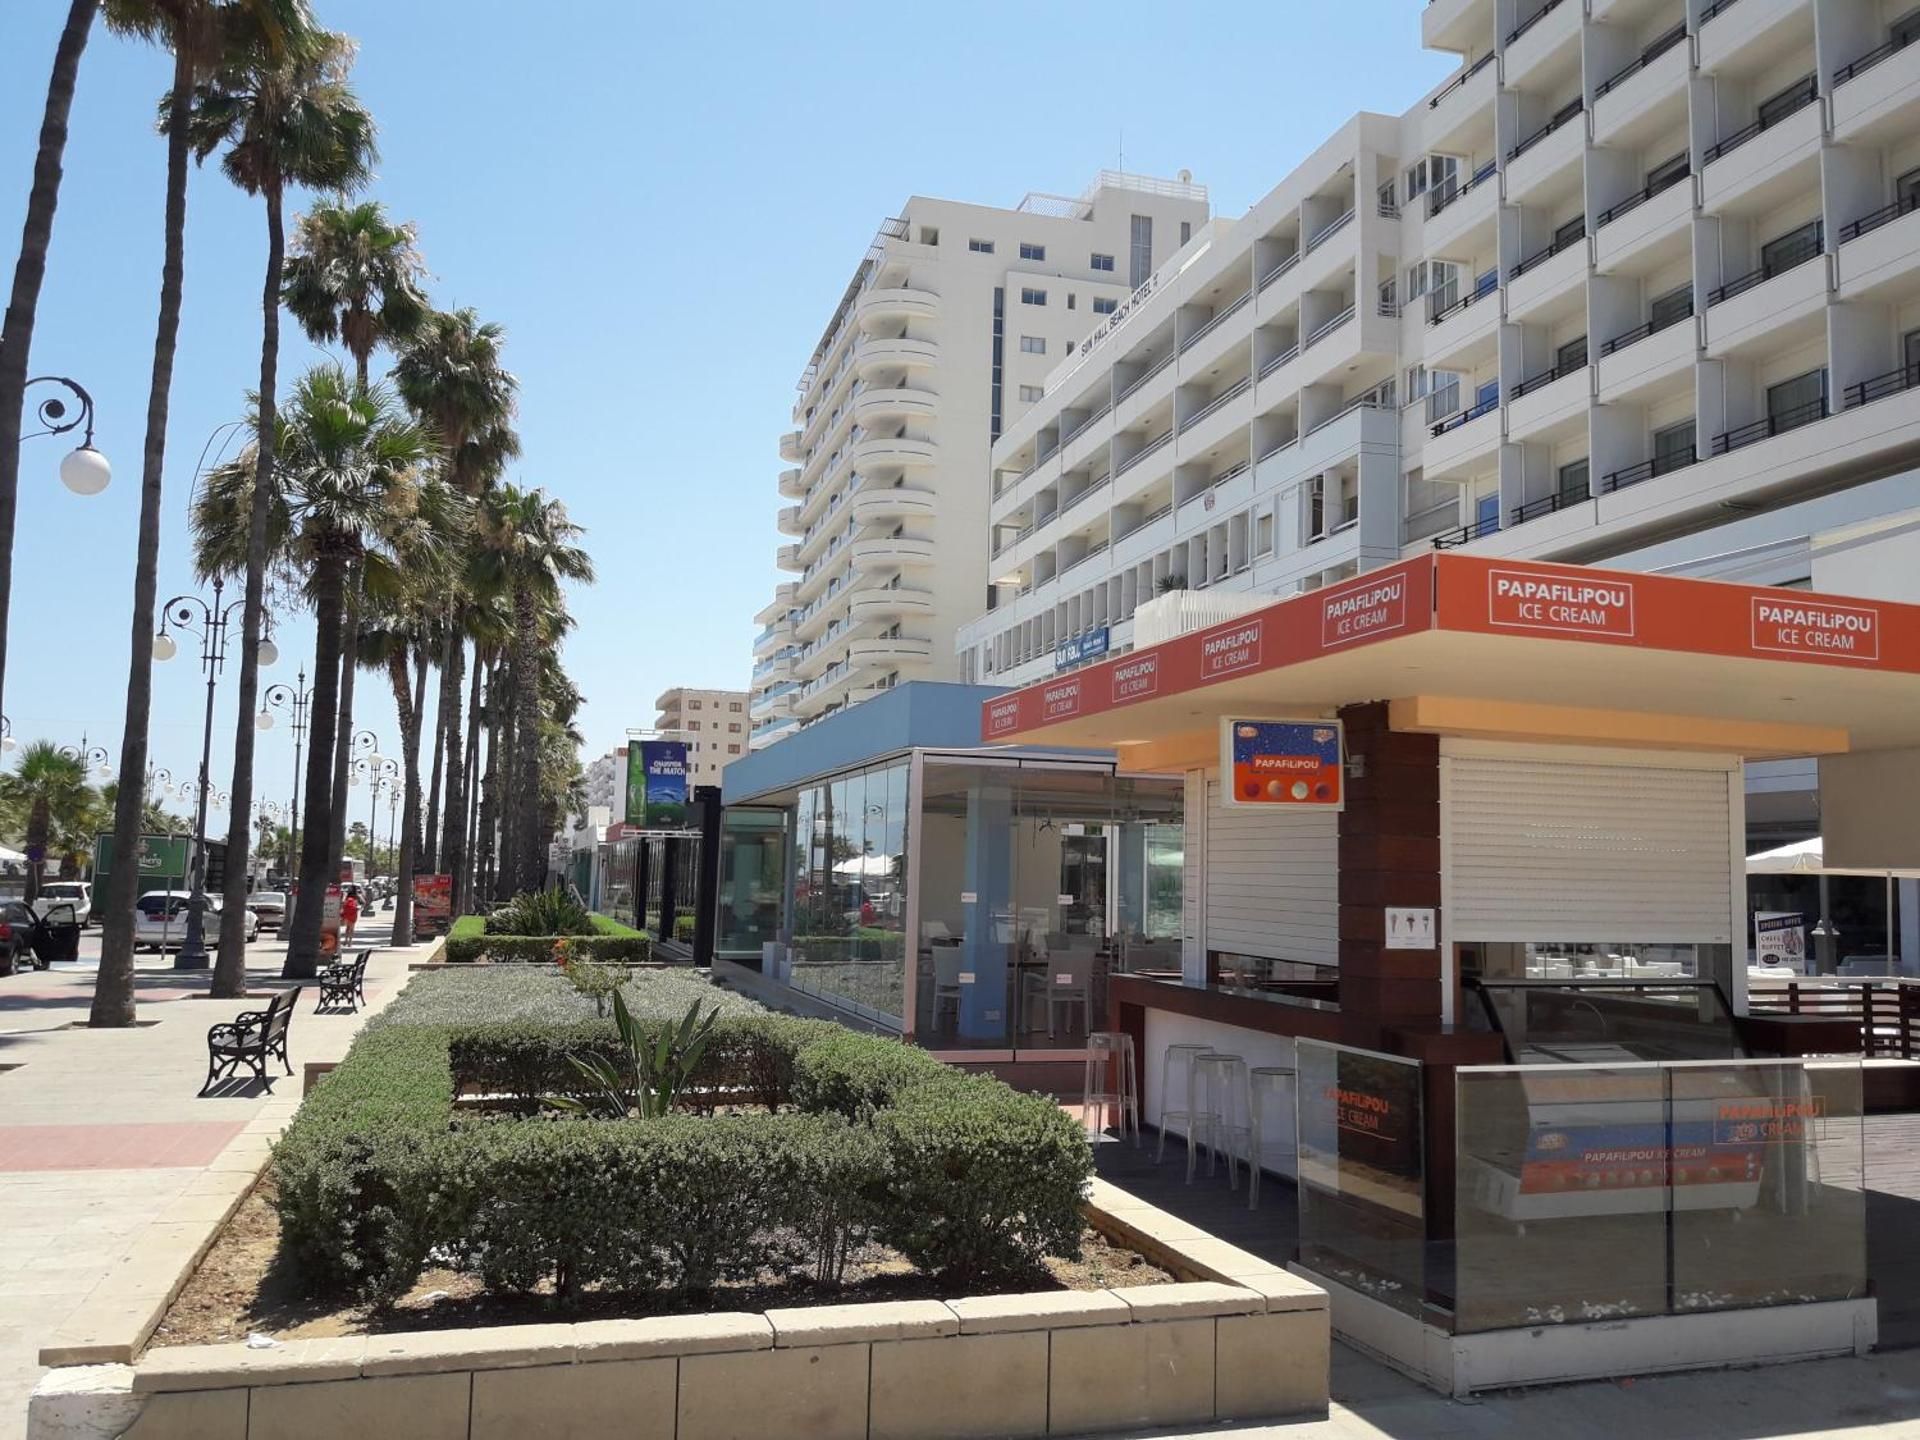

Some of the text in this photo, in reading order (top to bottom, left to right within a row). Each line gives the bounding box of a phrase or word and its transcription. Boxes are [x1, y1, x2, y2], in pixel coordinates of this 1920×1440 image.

[1109, 301, 1130, 331] BEACH
[1131, 281, 1151, 312] HOTEL
[1327, 583, 1400, 620] PAPAFiLiPOU
[1497, 579, 1625, 608] PAPAFiLiPOU
[1337, 608, 1387, 635] ICE CREAM
[1518, 603, 1606, 626] ICE CREAM
[1759, 606, 1872, 633] PAPAFiLiPOU
[1777, 627, 1854, 650] ICE CREAM
[1212, 649, 1249, 670] ICE CREAM
[1119, 678, 1148, 695] ICE CREAM
[1049, 700, 1073, 714] ICE CREAM
[649, 766, 686, 776] THE MATCH
[1348, 1110, 1378, 1130] CREAM
[1759, 1121, 1805, 1138] CREAM
[1674, 1147, 1706, 1159] CREAM
